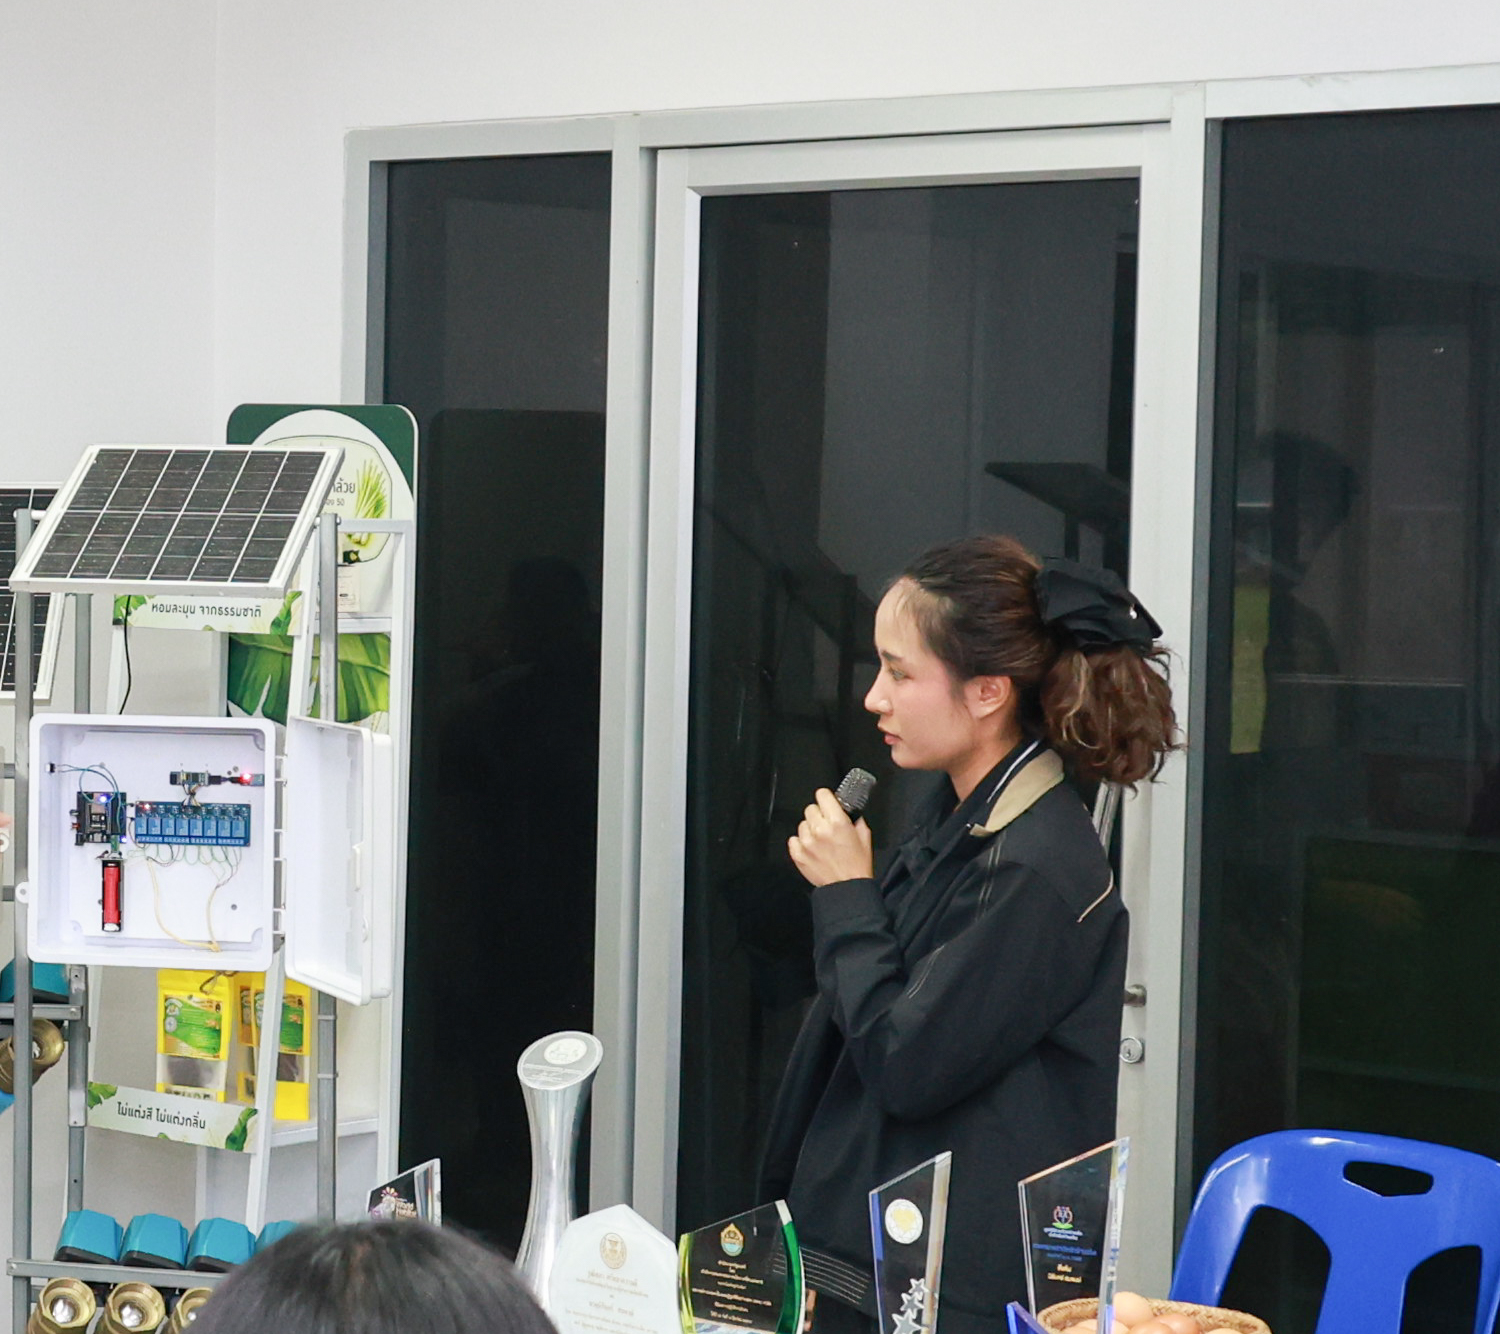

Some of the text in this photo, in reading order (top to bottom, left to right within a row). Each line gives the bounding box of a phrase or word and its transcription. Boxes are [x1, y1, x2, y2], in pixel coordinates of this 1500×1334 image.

[151, 602, 262, 618] หอมละมุน จากธรรมชาติ
[117, 1101, 206, 1130] ไม่แต่งสี ไม่แต่งกลิ่น
